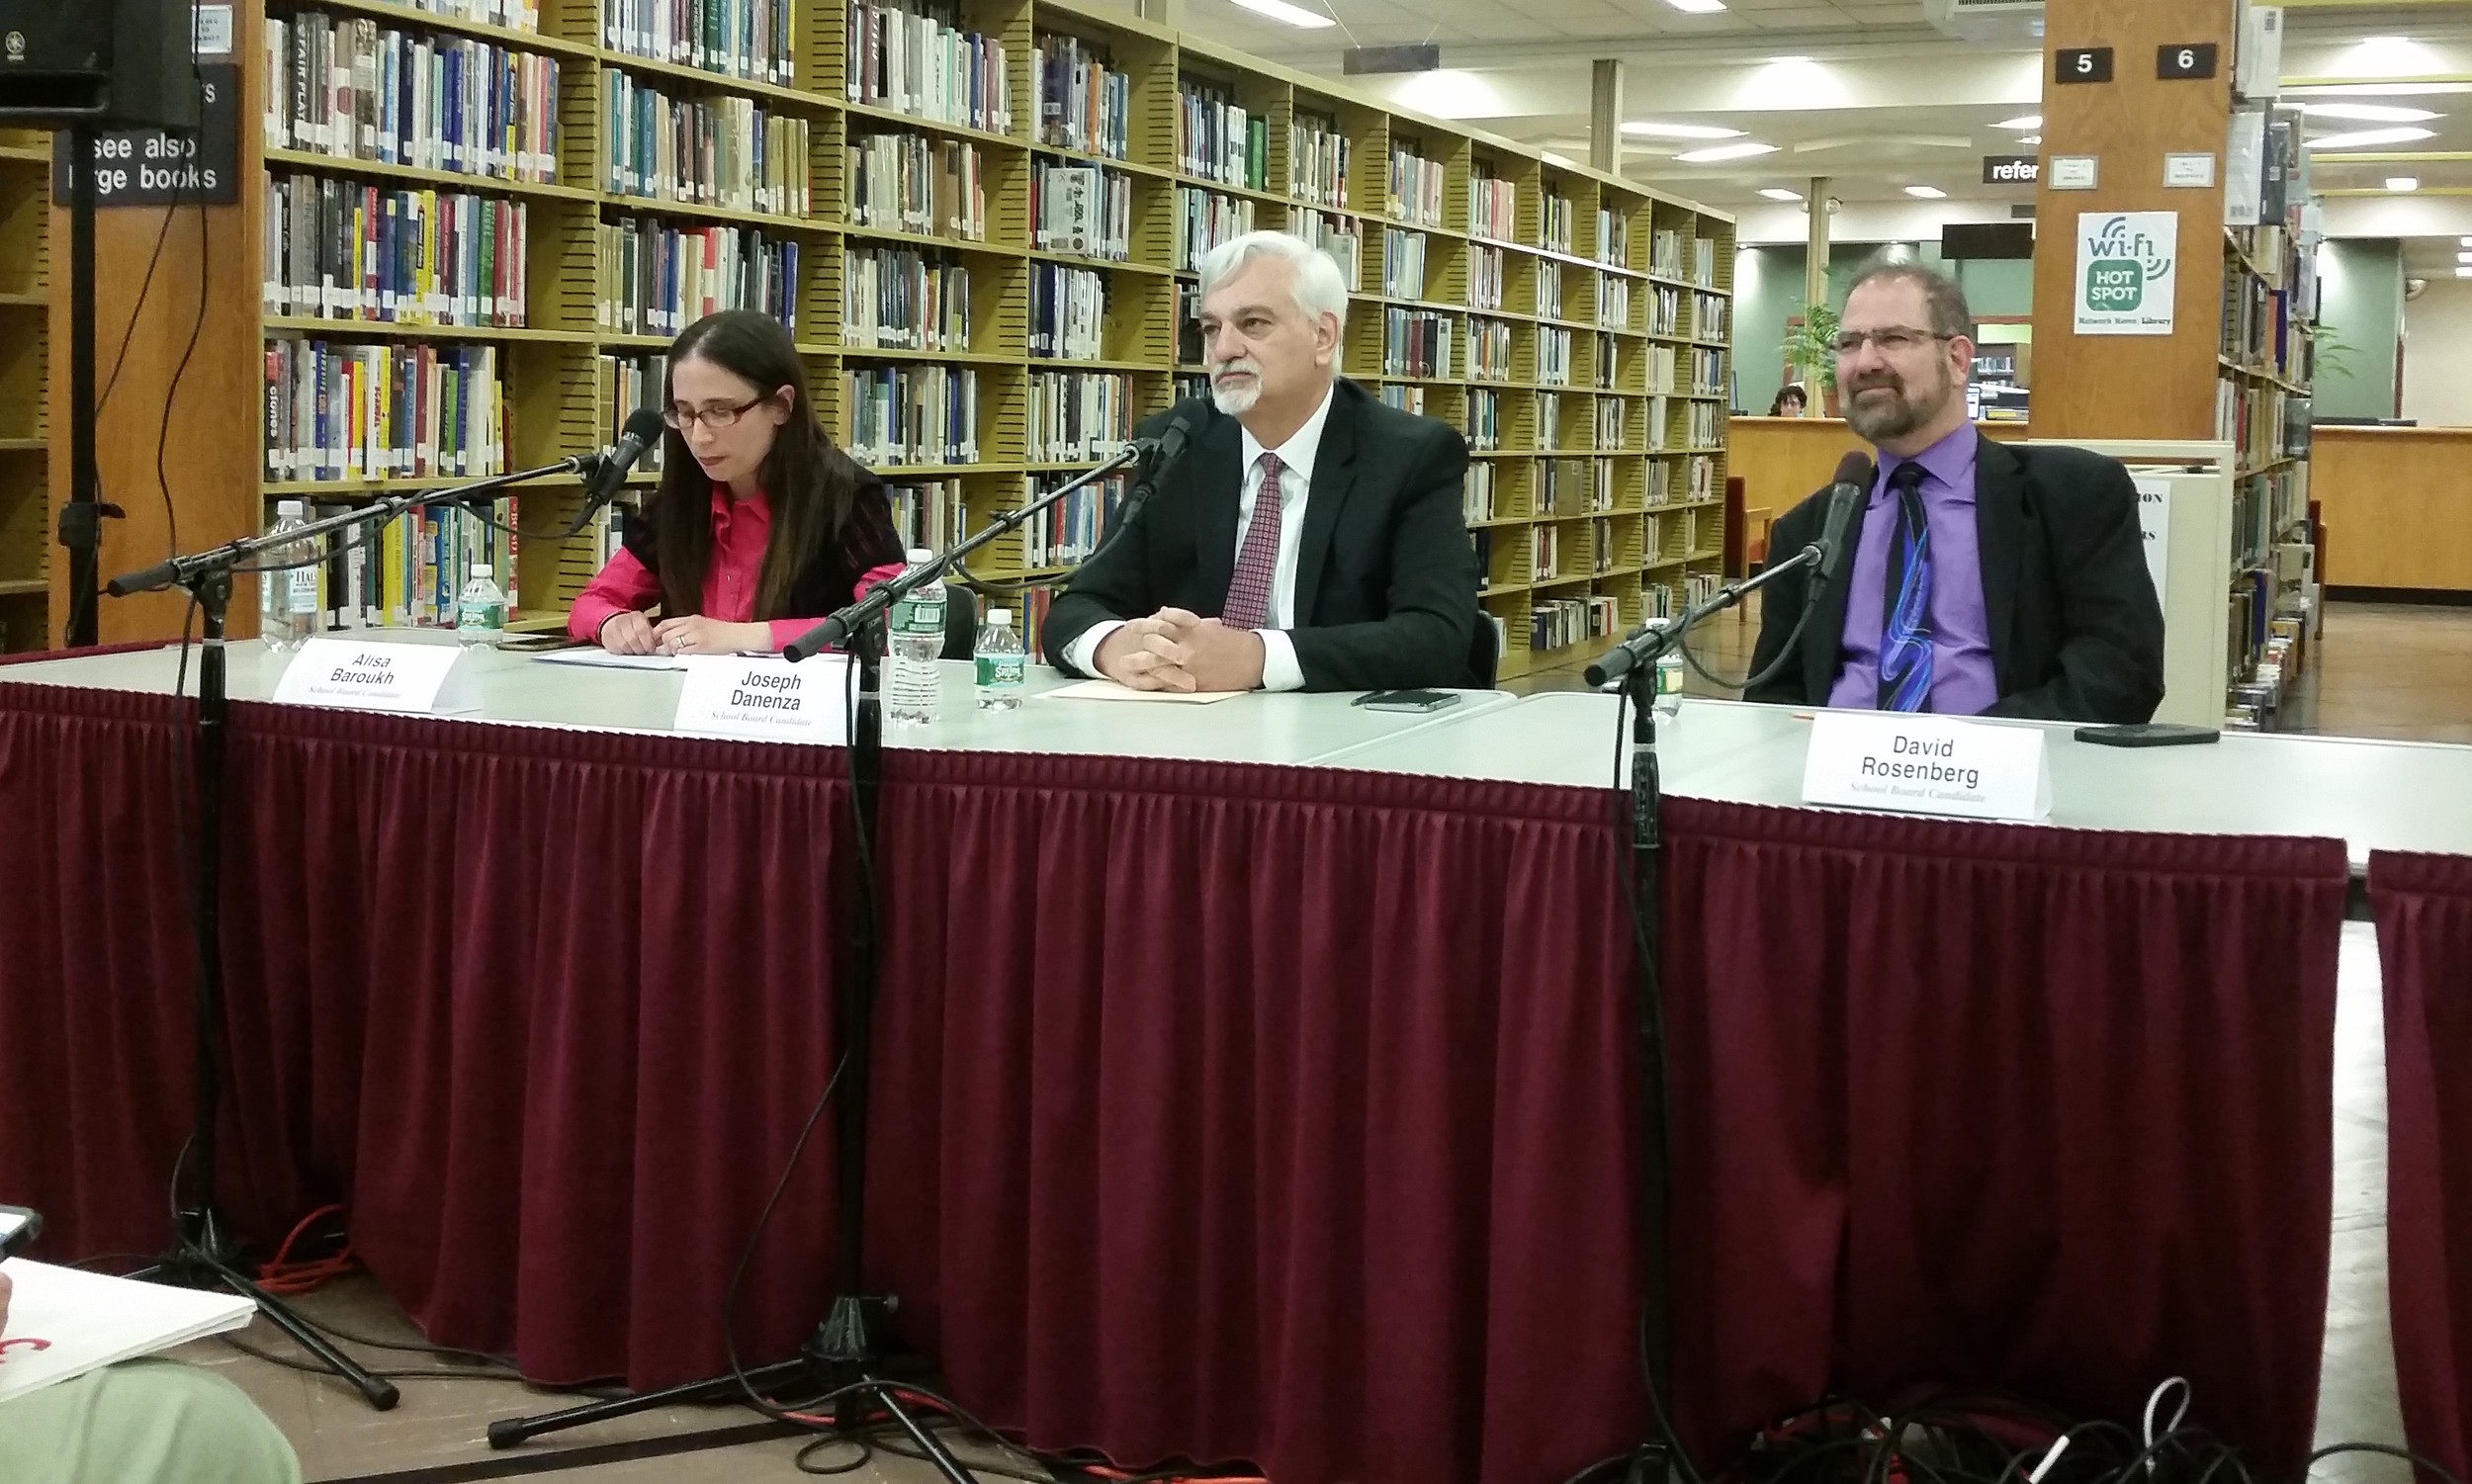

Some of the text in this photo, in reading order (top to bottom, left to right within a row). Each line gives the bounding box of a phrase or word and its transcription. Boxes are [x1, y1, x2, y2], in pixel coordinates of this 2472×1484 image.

[2077, 53, 2093, 73] 5
[2178, 49, 2194, 68] 6
[145, 132, 196, 158] also
[140, 164, 217, 189] books
[2096, 271, 2135, 285] HOT
[2091, 287, 2138, 301] SPOT
[2142, 316, 2171, 325] Library
[352, 654, 392, 667] Alisa
[330, 668, 395, 684] Baroukh
[742, 671, 802, 693] Joseph
[731, 689, 801, 711] Danenza
[712, 712, 813, 727] School Board Candidate
[1893, 736, 1954, 757] David
[1862, 756, 1980, 789] Rosenberg
[1851, 782, 1987, 803] School Board Candidate
